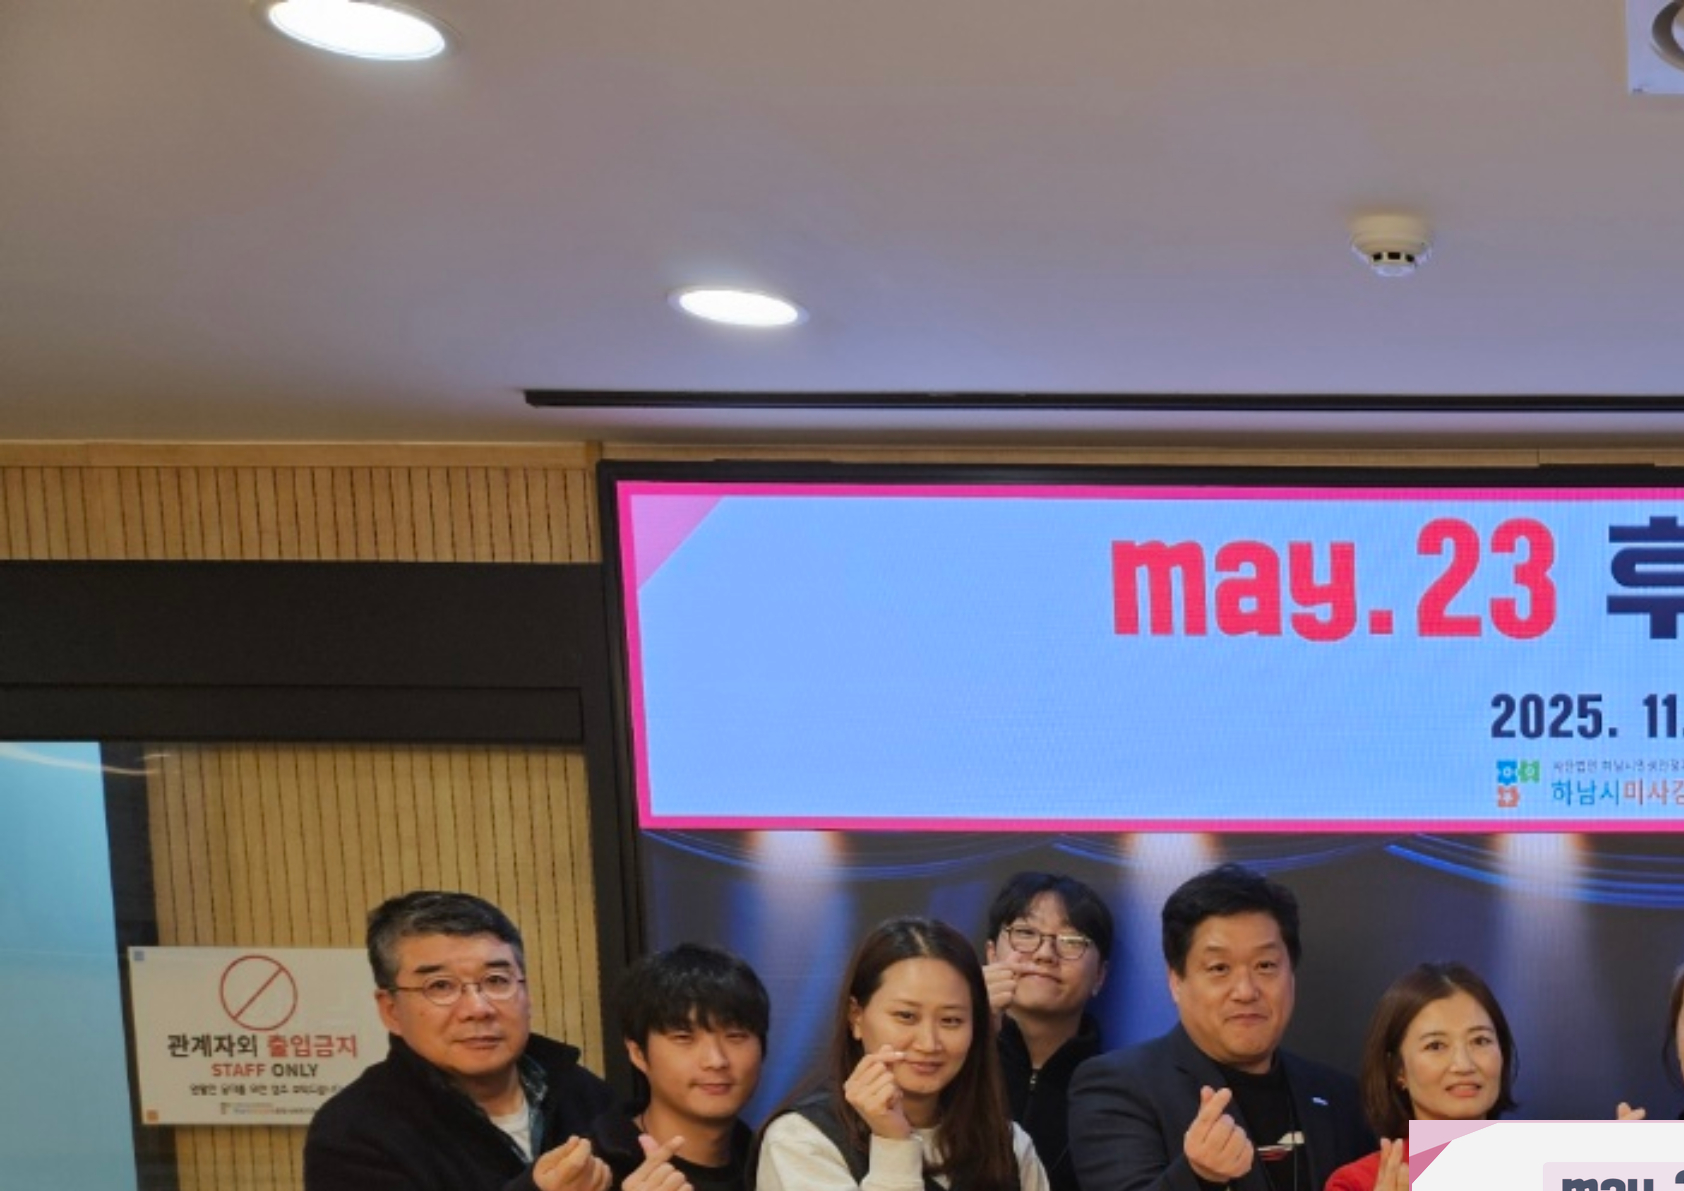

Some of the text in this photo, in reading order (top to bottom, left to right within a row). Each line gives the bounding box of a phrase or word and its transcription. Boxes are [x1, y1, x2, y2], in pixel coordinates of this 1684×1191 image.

[1491, 692, 1618, 740] 2025.
[167, 1034, 358, 1058] 관계자외 출입금지
[211, 1062, 319, 1078] STAFF ONLY
